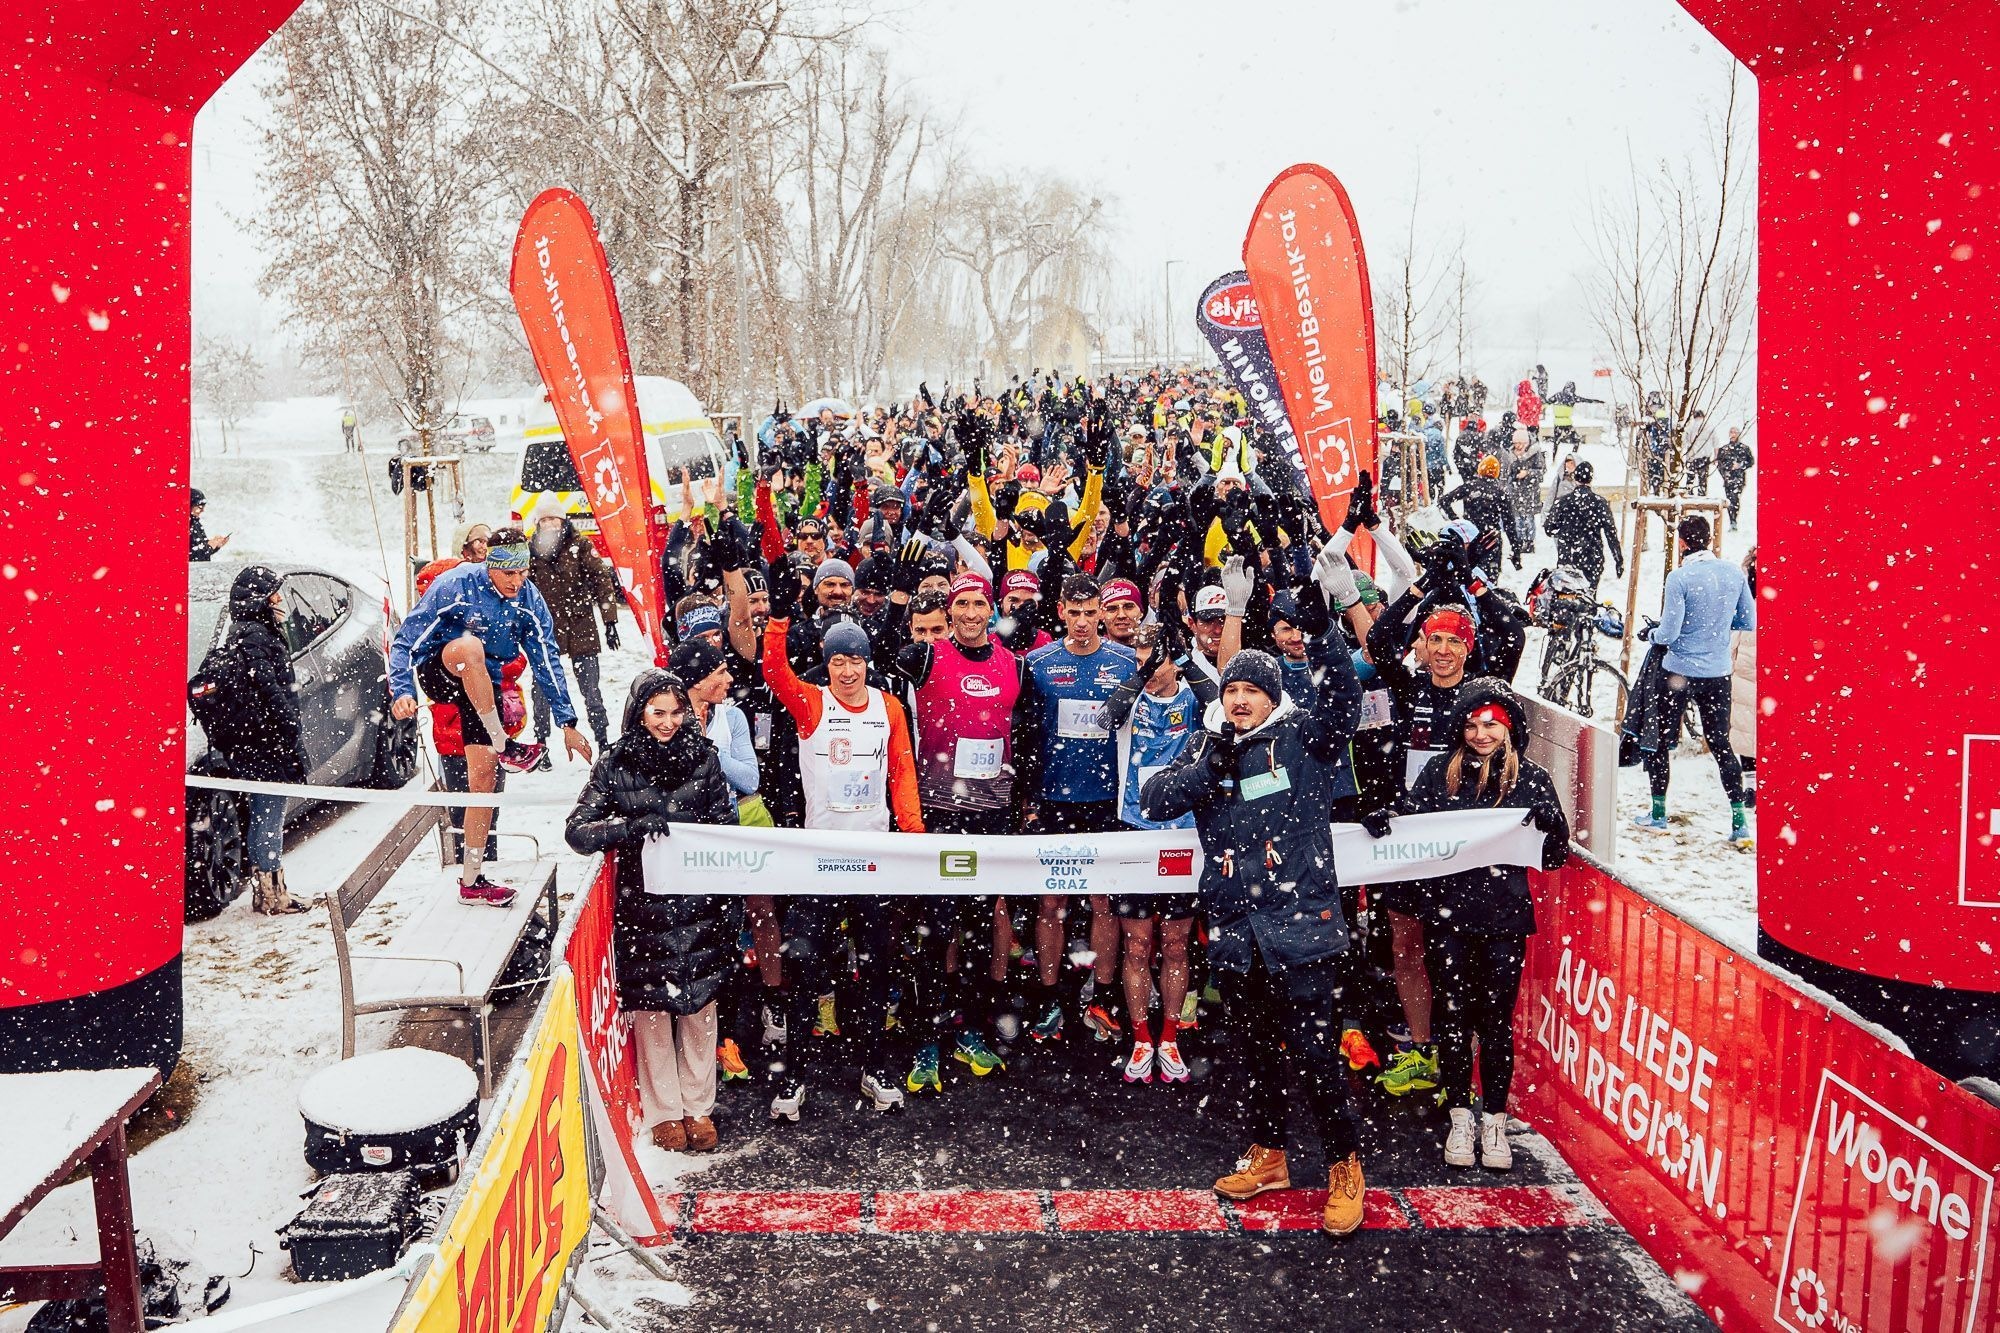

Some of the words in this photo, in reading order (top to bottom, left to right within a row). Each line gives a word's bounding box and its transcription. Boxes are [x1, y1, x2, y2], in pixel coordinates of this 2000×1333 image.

[843, 783, 870, 797] 534
[1161, 850, 1192, 858] Woche
[1373, 840, 1467, 861] HIKIMUS
[683, 850, 775, 873] HIKIMUS
[817, 864, 867, 872] SPARKASSE
[1040, 858, 1095, 866] WINTER
[1051, 866, 1082, 876] RUN
[1045, 877, 1088, 890] GRAZ
[1556, 947, 1617, 1032] AUS
[1619, 994, 1717, 1113] LIEBE
[1537, 994, 1581, 1085] ZUR
[1826, 1100, 1971, 1240] Woche
